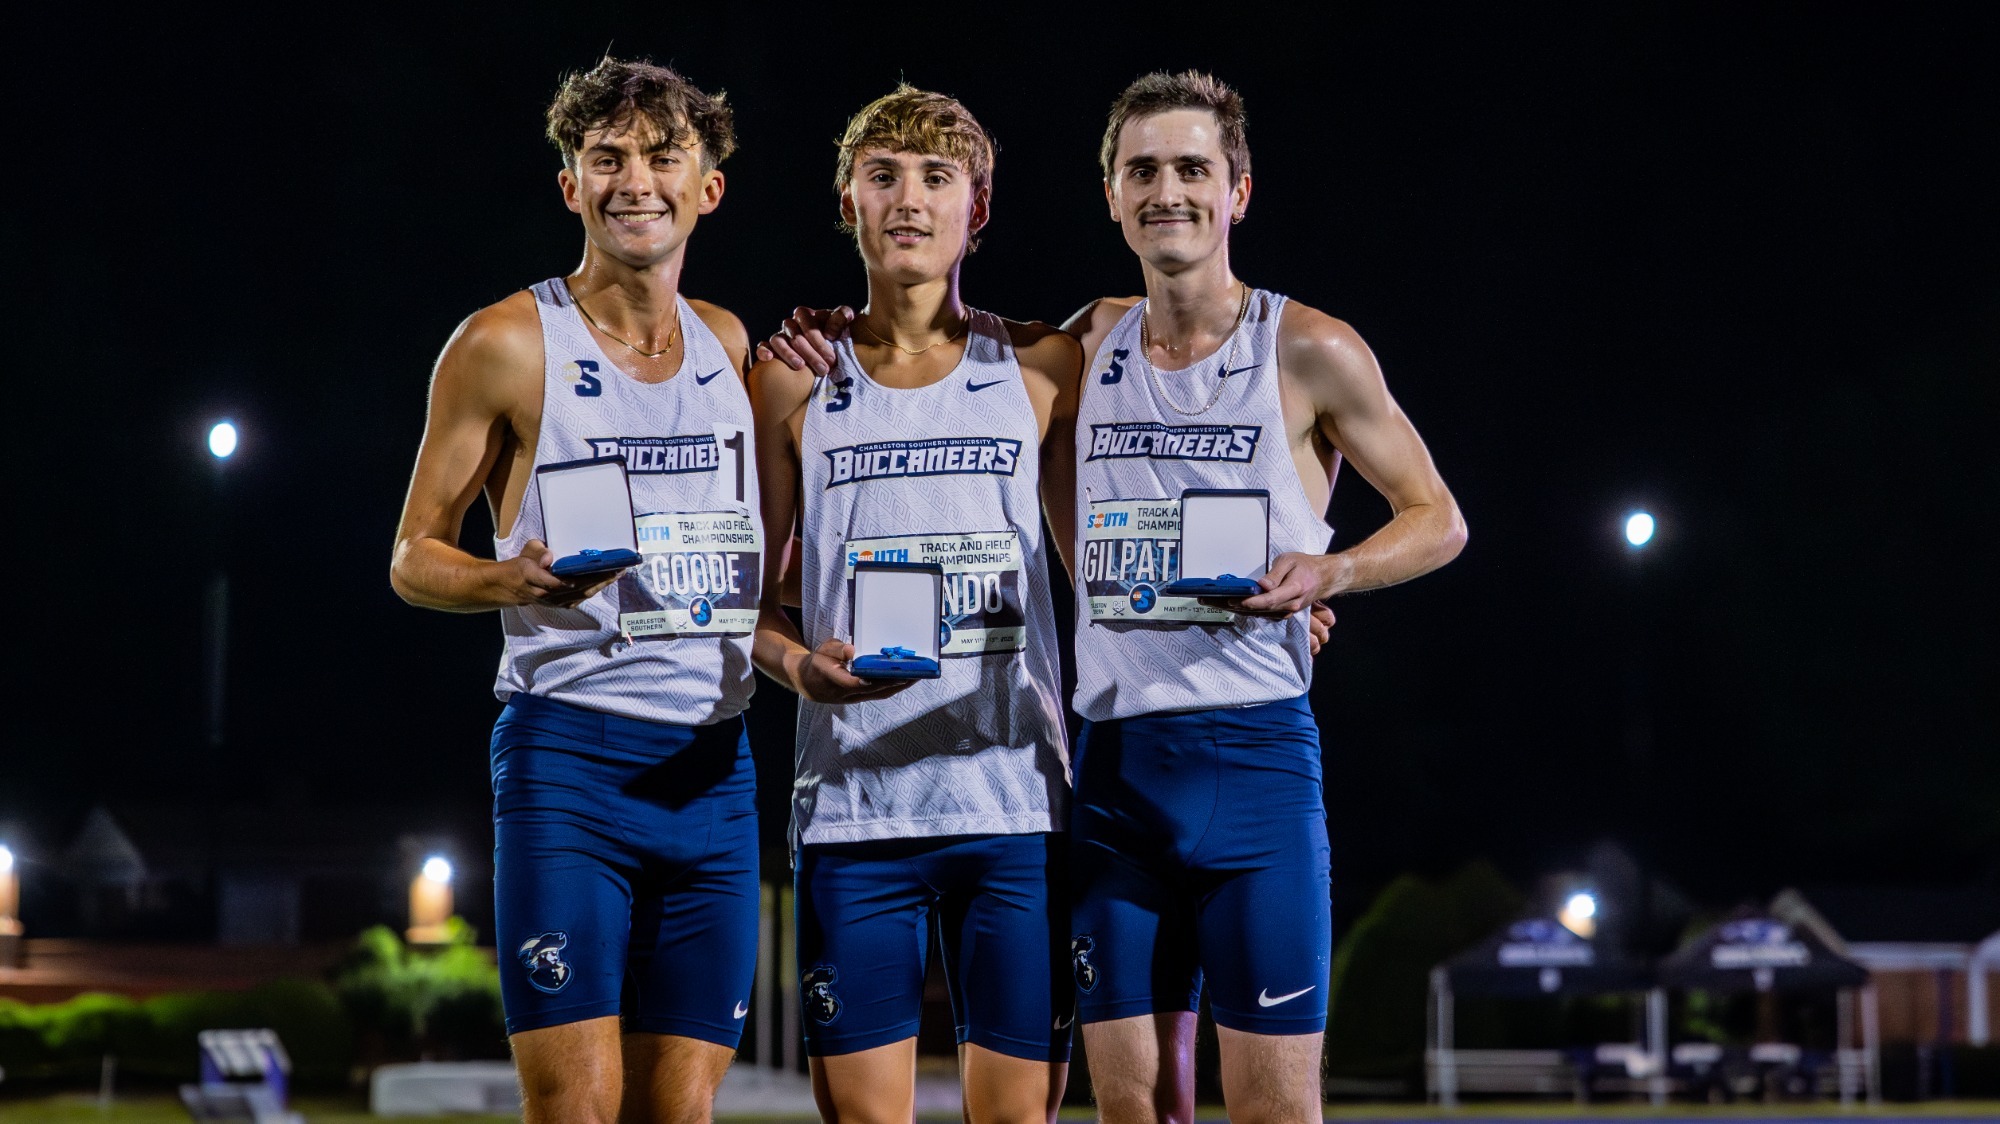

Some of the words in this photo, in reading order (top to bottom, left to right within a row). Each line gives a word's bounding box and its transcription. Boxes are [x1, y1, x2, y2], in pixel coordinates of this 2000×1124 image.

[1101, 349, 1129, 385] S
[574, 360, 602, 397] S
[664, 437, 695, 445] SOUTHERN
[858, 442, 906, 452] CHARLESTON
[908, 440, 947, 449] SOUTHERN
[949, 438, 991, 446] UNIVERSITY
[1093, 427, 1256, 460] BUCCANEERS
[594, 442, 719, 471] BUCCANEE
[830, 440, 1019, 484] BUCCANEERS
[723, 430, 745, 503] 1
[1137, 507, 1169, 517] TRACK
[638, 526, 670, 541] UTH
[678, 521, 710, 532] TRACK
[712, 520, 732, 531] AND
[682, 533, 755, 544] CHAMPIONSHIPS
[919, 542, 957, 554] TRACK
[959, 542, 983, 552] AND
[985, 540, 1011, 550] FIELD
[922, 552, 1012, 564] CHAMPIONSHIPS
[1084, 540, 1180, 583] GILPAT
[651, 553, 741, 596] GOODE
[943, 573, 1003, 616] NDO
[626, 617, 666, 626] CHARLESTON
[631, 623, 663, 632] SOUTHERN
